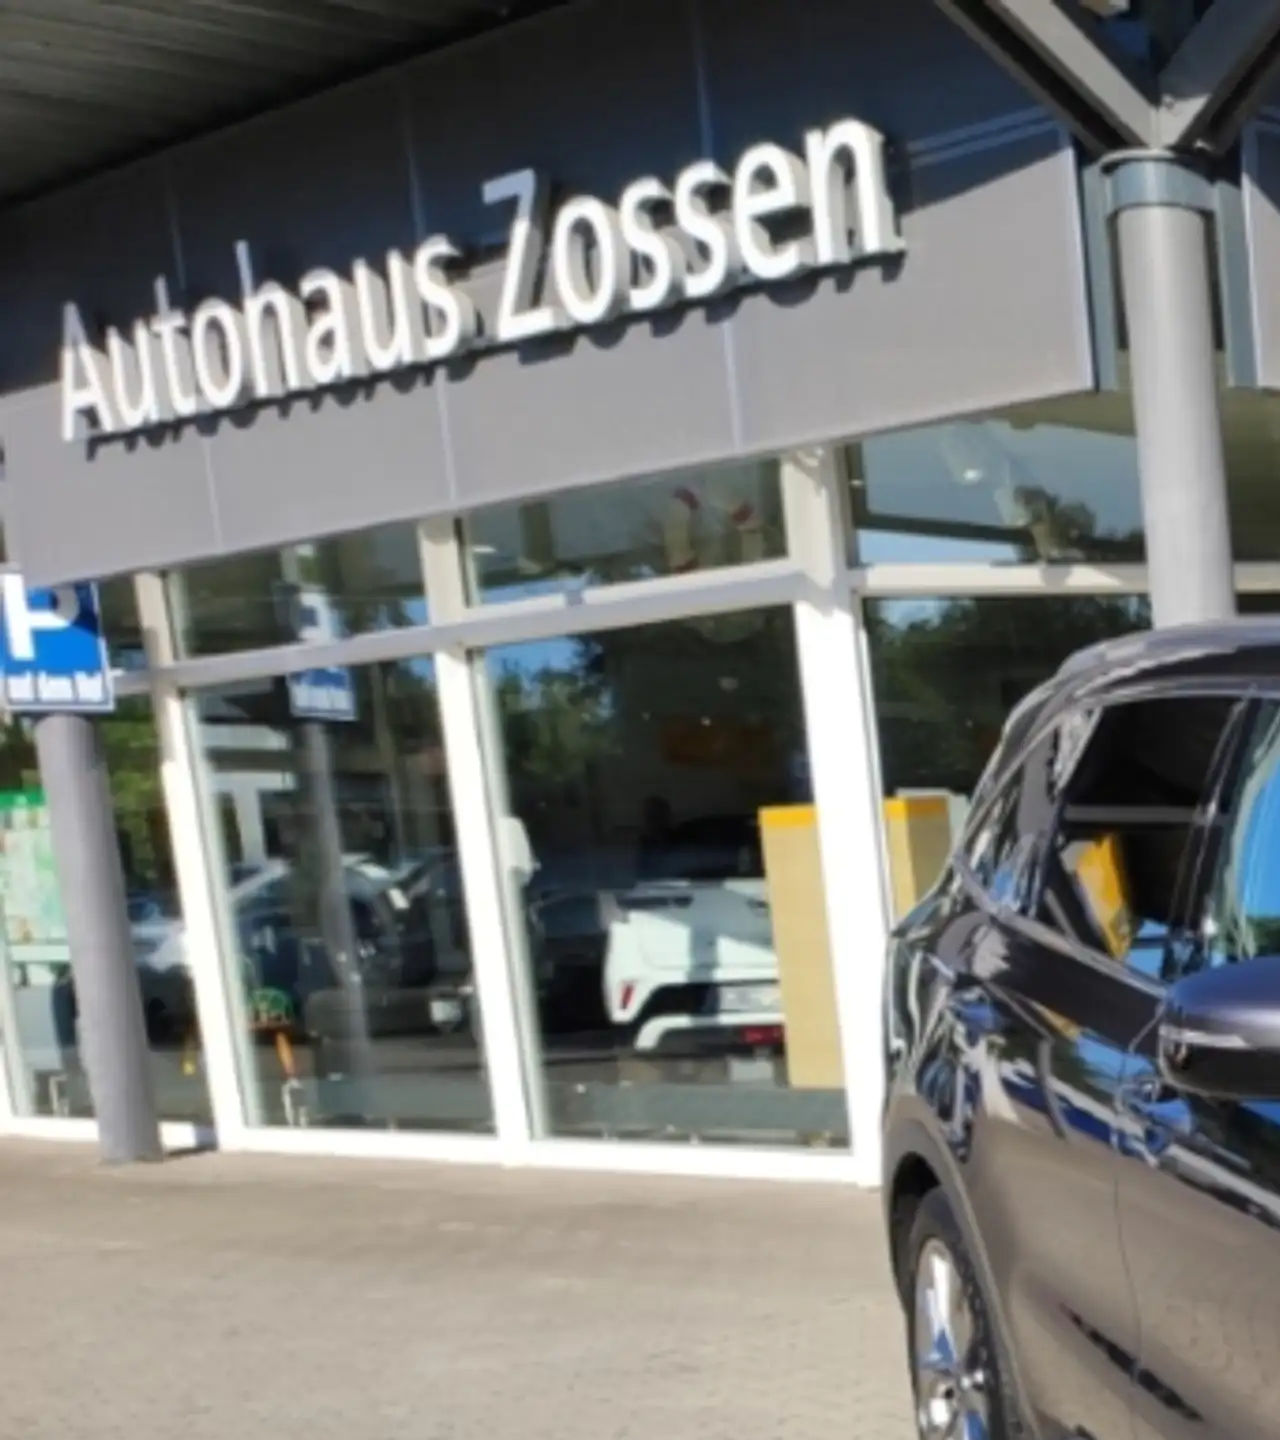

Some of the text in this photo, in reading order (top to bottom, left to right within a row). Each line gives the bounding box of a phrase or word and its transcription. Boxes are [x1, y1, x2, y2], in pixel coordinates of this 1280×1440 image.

[61, 117, 905, 443] Autohaus Zossen
[4, 573, 79, 661] P
